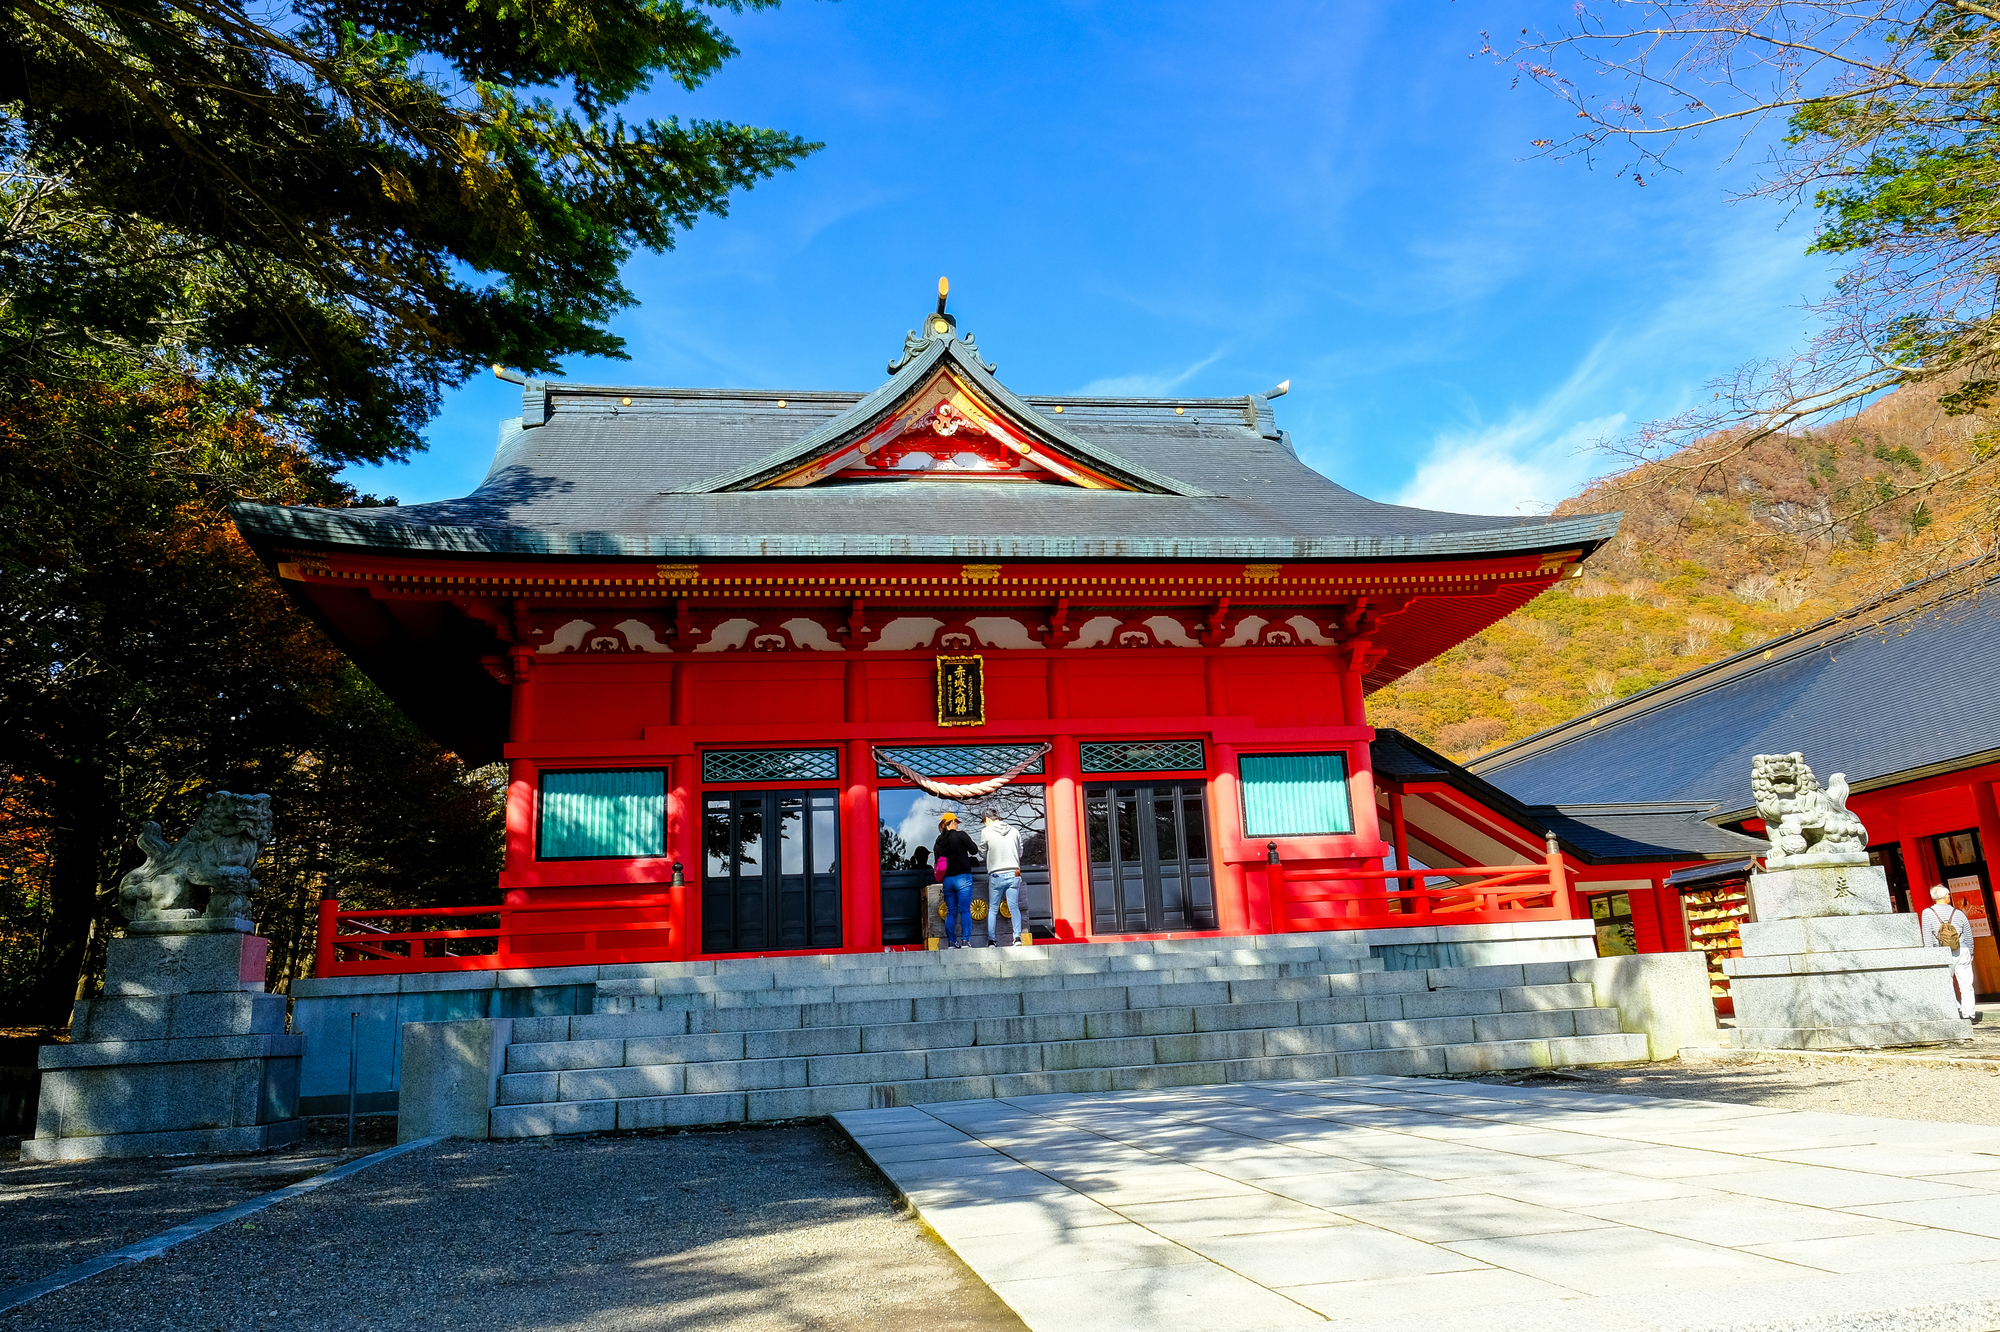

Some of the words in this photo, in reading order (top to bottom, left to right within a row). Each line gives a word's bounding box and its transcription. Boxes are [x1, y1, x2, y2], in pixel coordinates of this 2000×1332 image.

[954, 664, 967, 715] 赤城大明神
[1833, 876, 1859, 903] 奉
